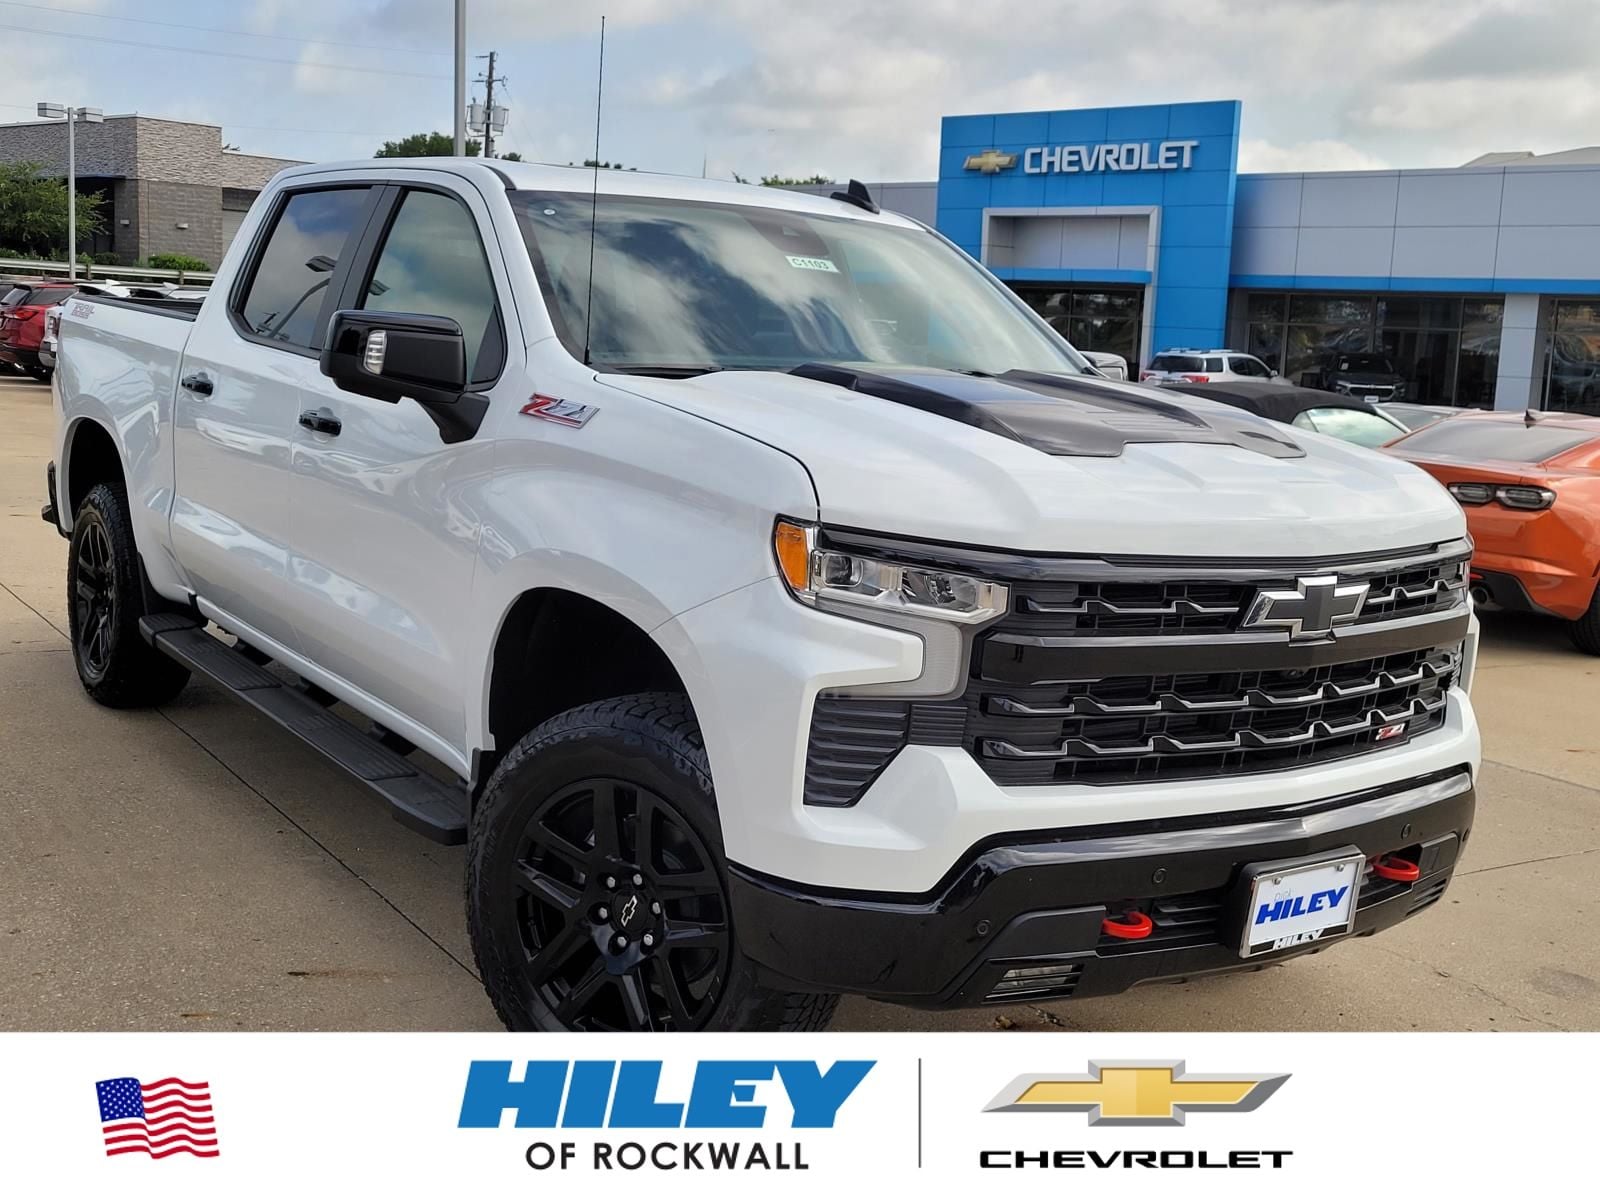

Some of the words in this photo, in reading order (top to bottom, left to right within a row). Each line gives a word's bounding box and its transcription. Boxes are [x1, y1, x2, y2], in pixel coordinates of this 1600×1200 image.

[1024, 140, 1200, 174] CHEVROLET
[1255, 885, 1349, 925] HILEY
[1272, 928, 1325, 951] HILEY
